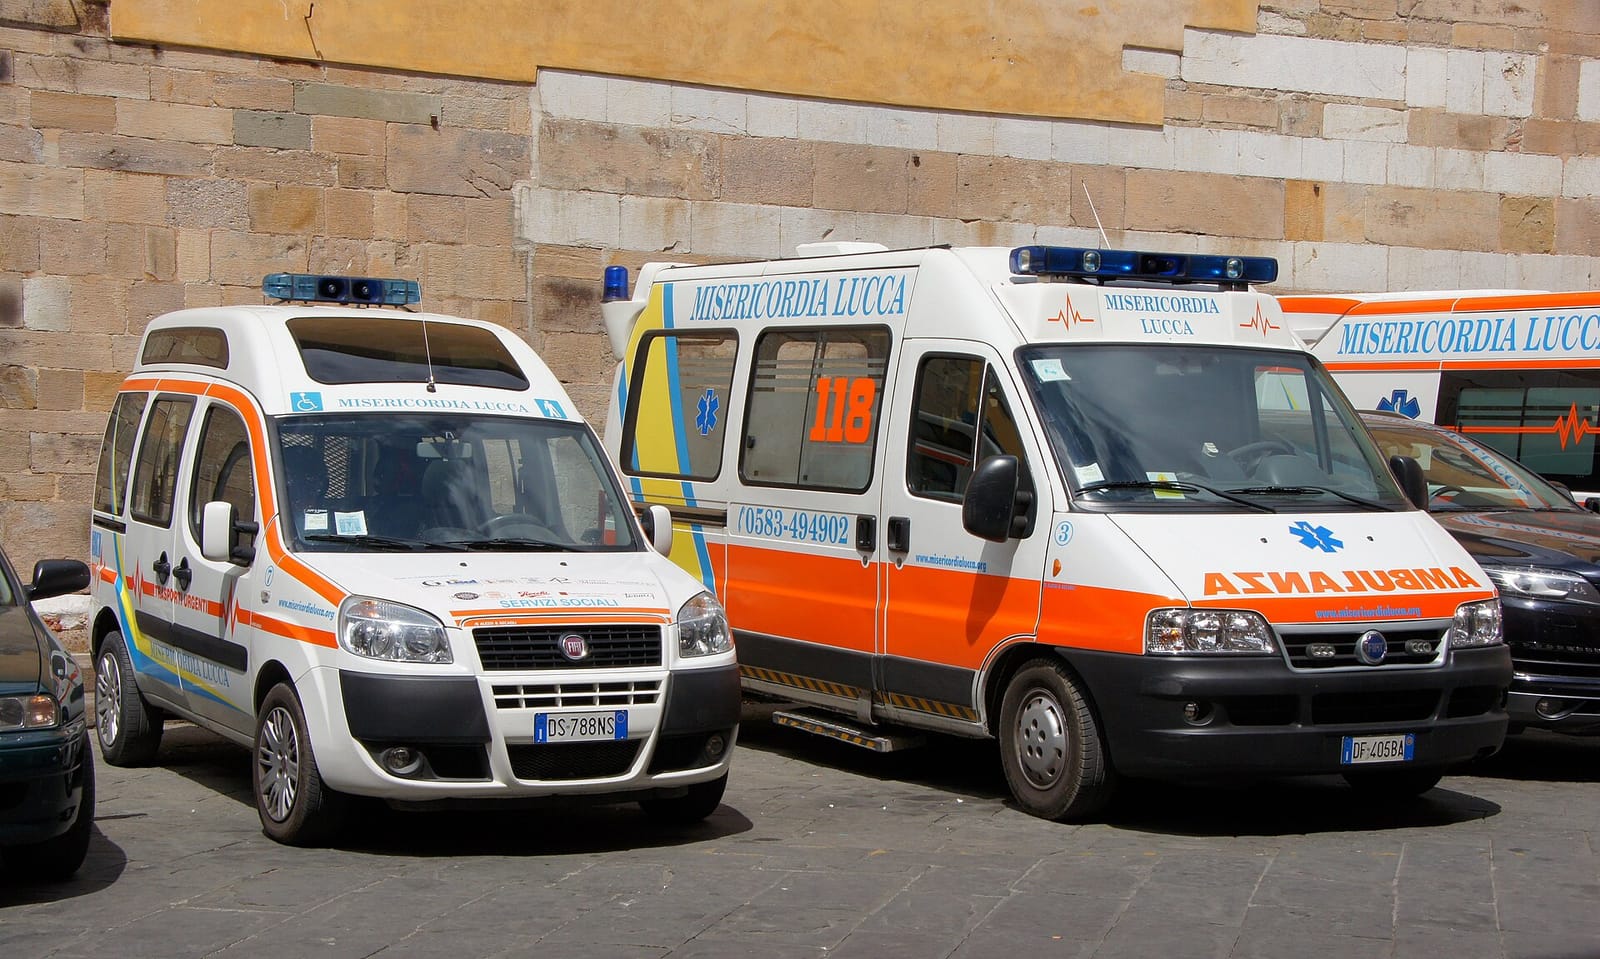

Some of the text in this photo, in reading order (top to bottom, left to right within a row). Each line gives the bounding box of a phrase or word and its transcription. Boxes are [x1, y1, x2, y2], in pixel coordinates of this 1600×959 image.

[690, 274, 906, 321] MISERICORDIA LUCCA
[1104, 293, 1220, 315] MISERICORDIA
[1140, 318, 1194, 336] LUCCA
[1336, 313, 1600, 356] MISERICORDIA LUCC
[338, 397, 530, 413] MISERICORDIA LUCCA
[809, 376, 877, 444] 118
[745, 506, 850, 545] 0583-494902
[1058, 523, 1070, 543] 3
[915, 553, 988, 573] www.misericordialucca.org
[155, 585, 208, 613] TRASPORTI URGENTI
[278, 599, 335, 621] www.misericordialucca.org
[500, 598, 619, 609] SERVIZI SOCIALI
[1315, 605, 1421, 618] www.misericordialucca.org
[567, 642, 586, 653] FIAT
[203, 660, 231, 688] LUCCA
